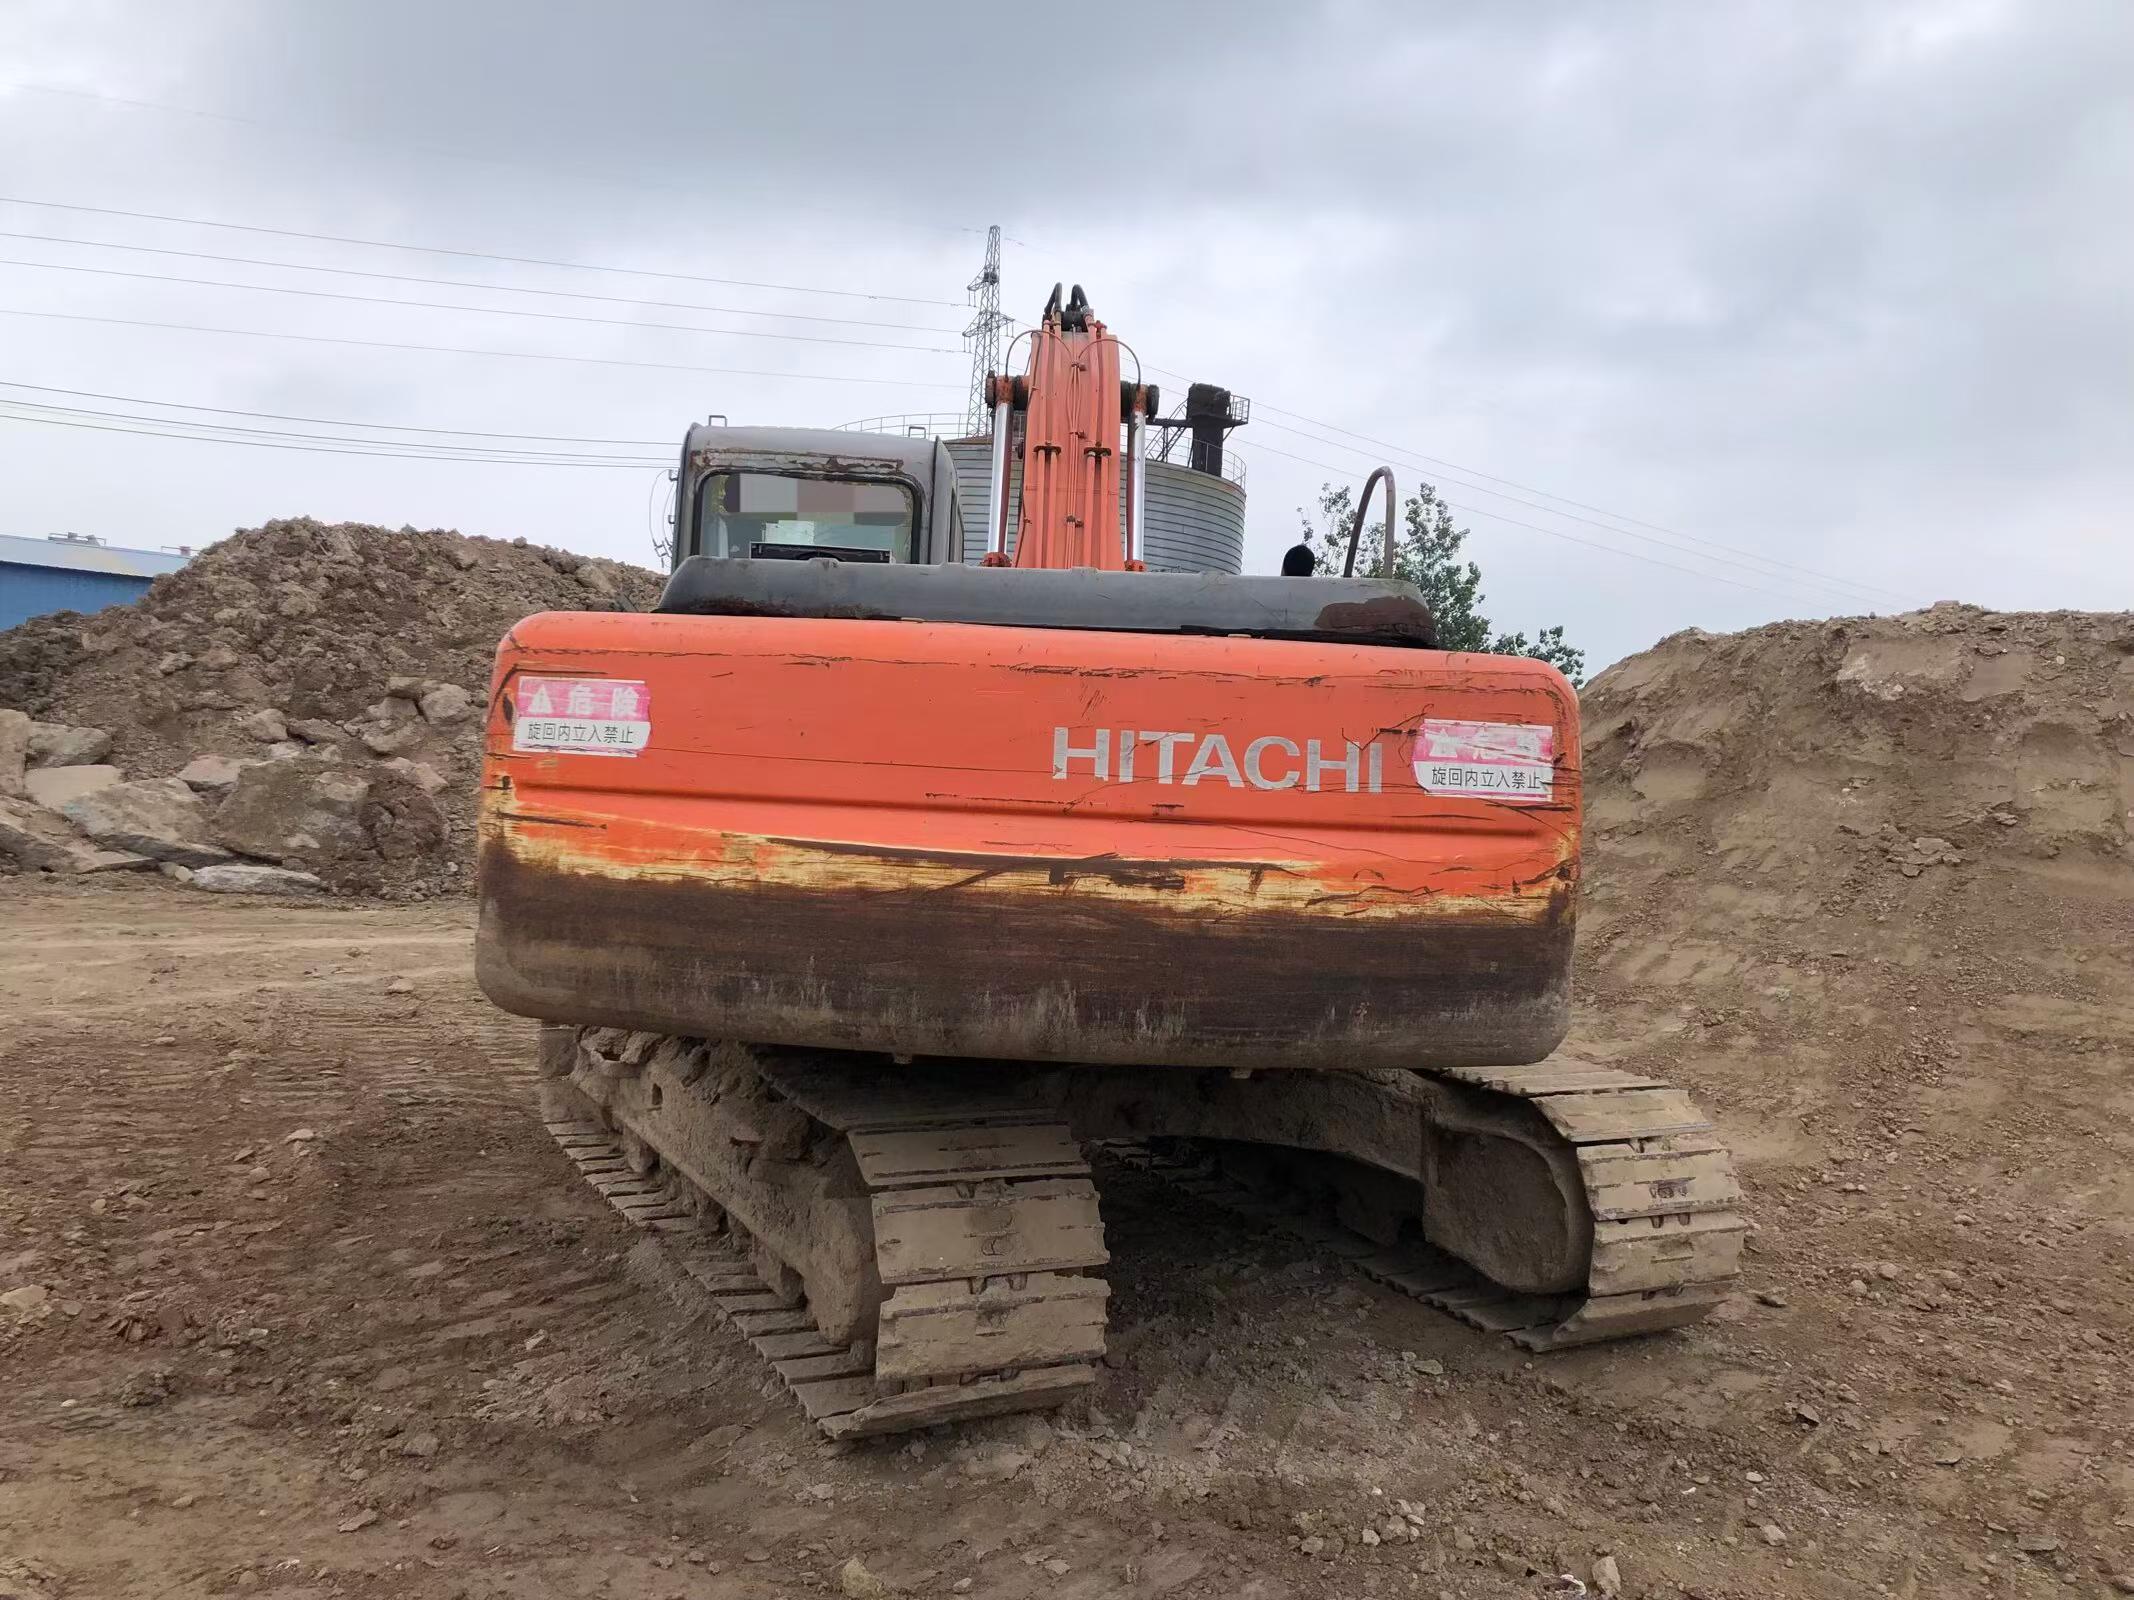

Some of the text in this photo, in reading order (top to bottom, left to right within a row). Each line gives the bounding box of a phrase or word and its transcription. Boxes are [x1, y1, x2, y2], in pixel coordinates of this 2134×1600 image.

[527, 722, 634, 744] 旋回内立入禁止
[1053, 727, 1383, 794] HITACHI
[1431, 766, 1541, 789] 旋回内立入禁止
